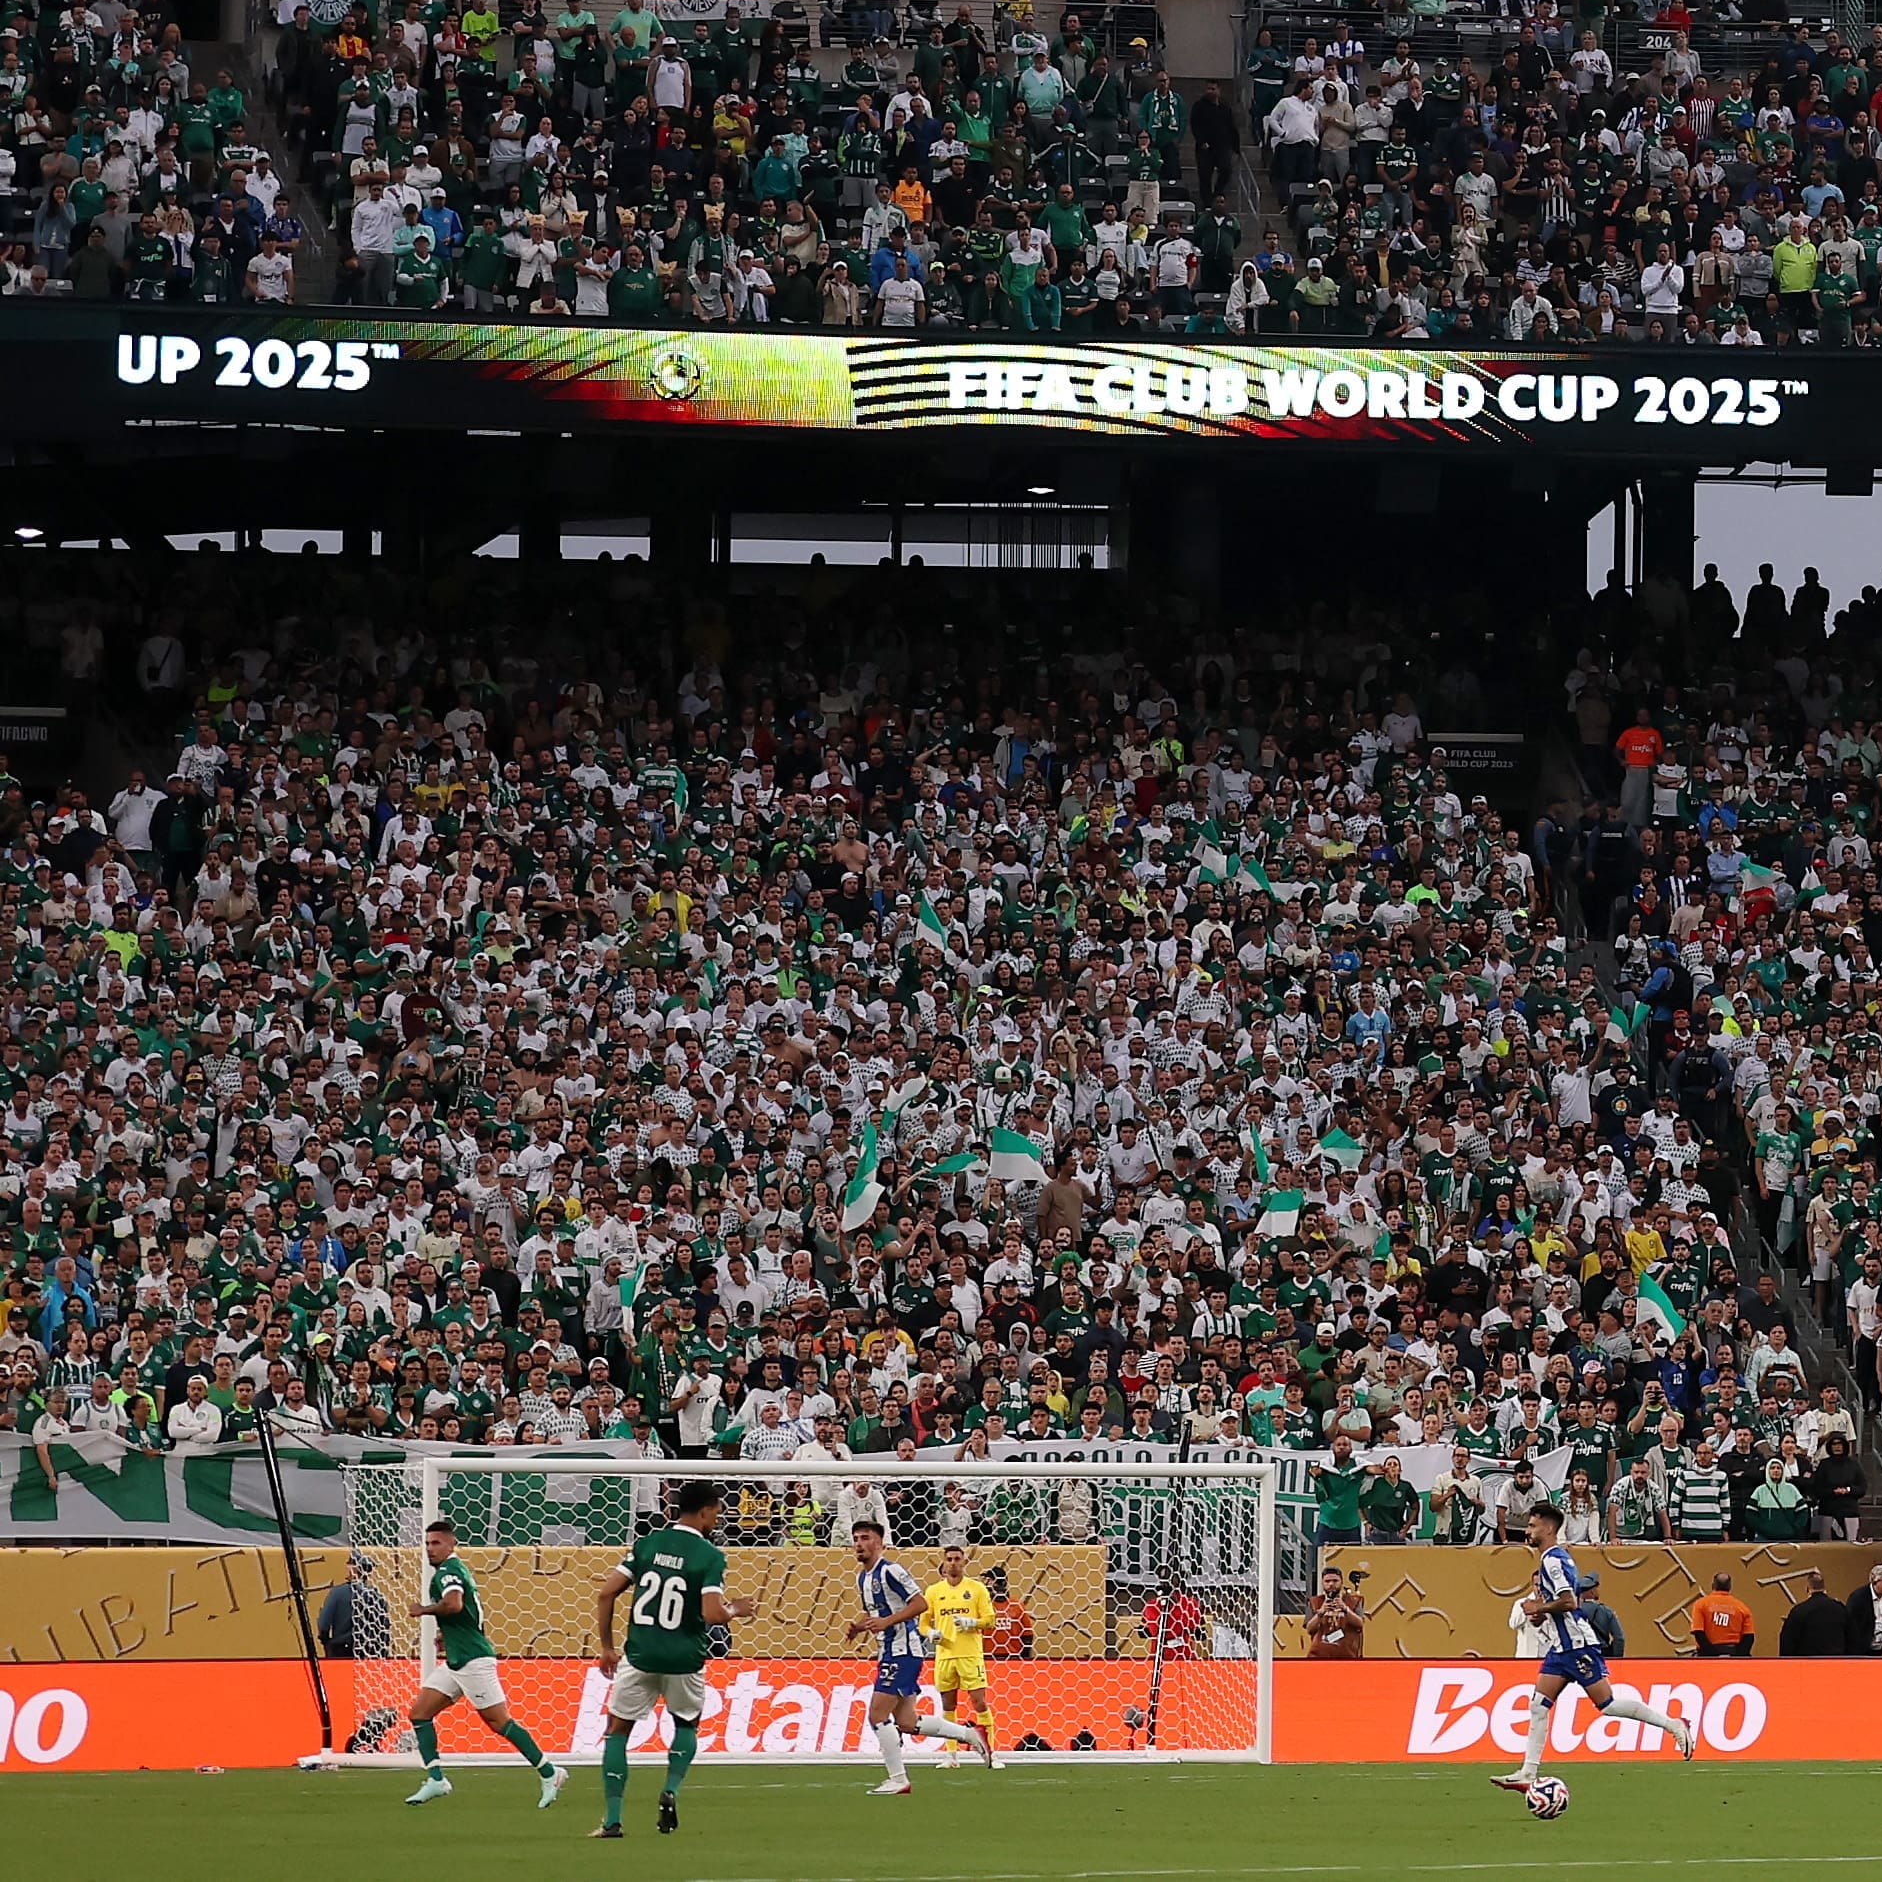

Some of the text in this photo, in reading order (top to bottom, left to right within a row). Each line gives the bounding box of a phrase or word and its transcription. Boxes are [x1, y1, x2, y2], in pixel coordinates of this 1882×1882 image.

[1646, 35, 1672, 49] 204
[115, 334, 201, 385] UP
[947, 361, 1079, 412] FIFA
[1097, 364, 1250, 416] CLUB
[1263, 368, 1486, 419] WORLD
[1498, 373, 1620, 423] CUP
[653, 1551, 684, 1570] MURILO
[633, 1570, 688, 1630] 26
[1407, 1667, 1767, 1757] Betano
